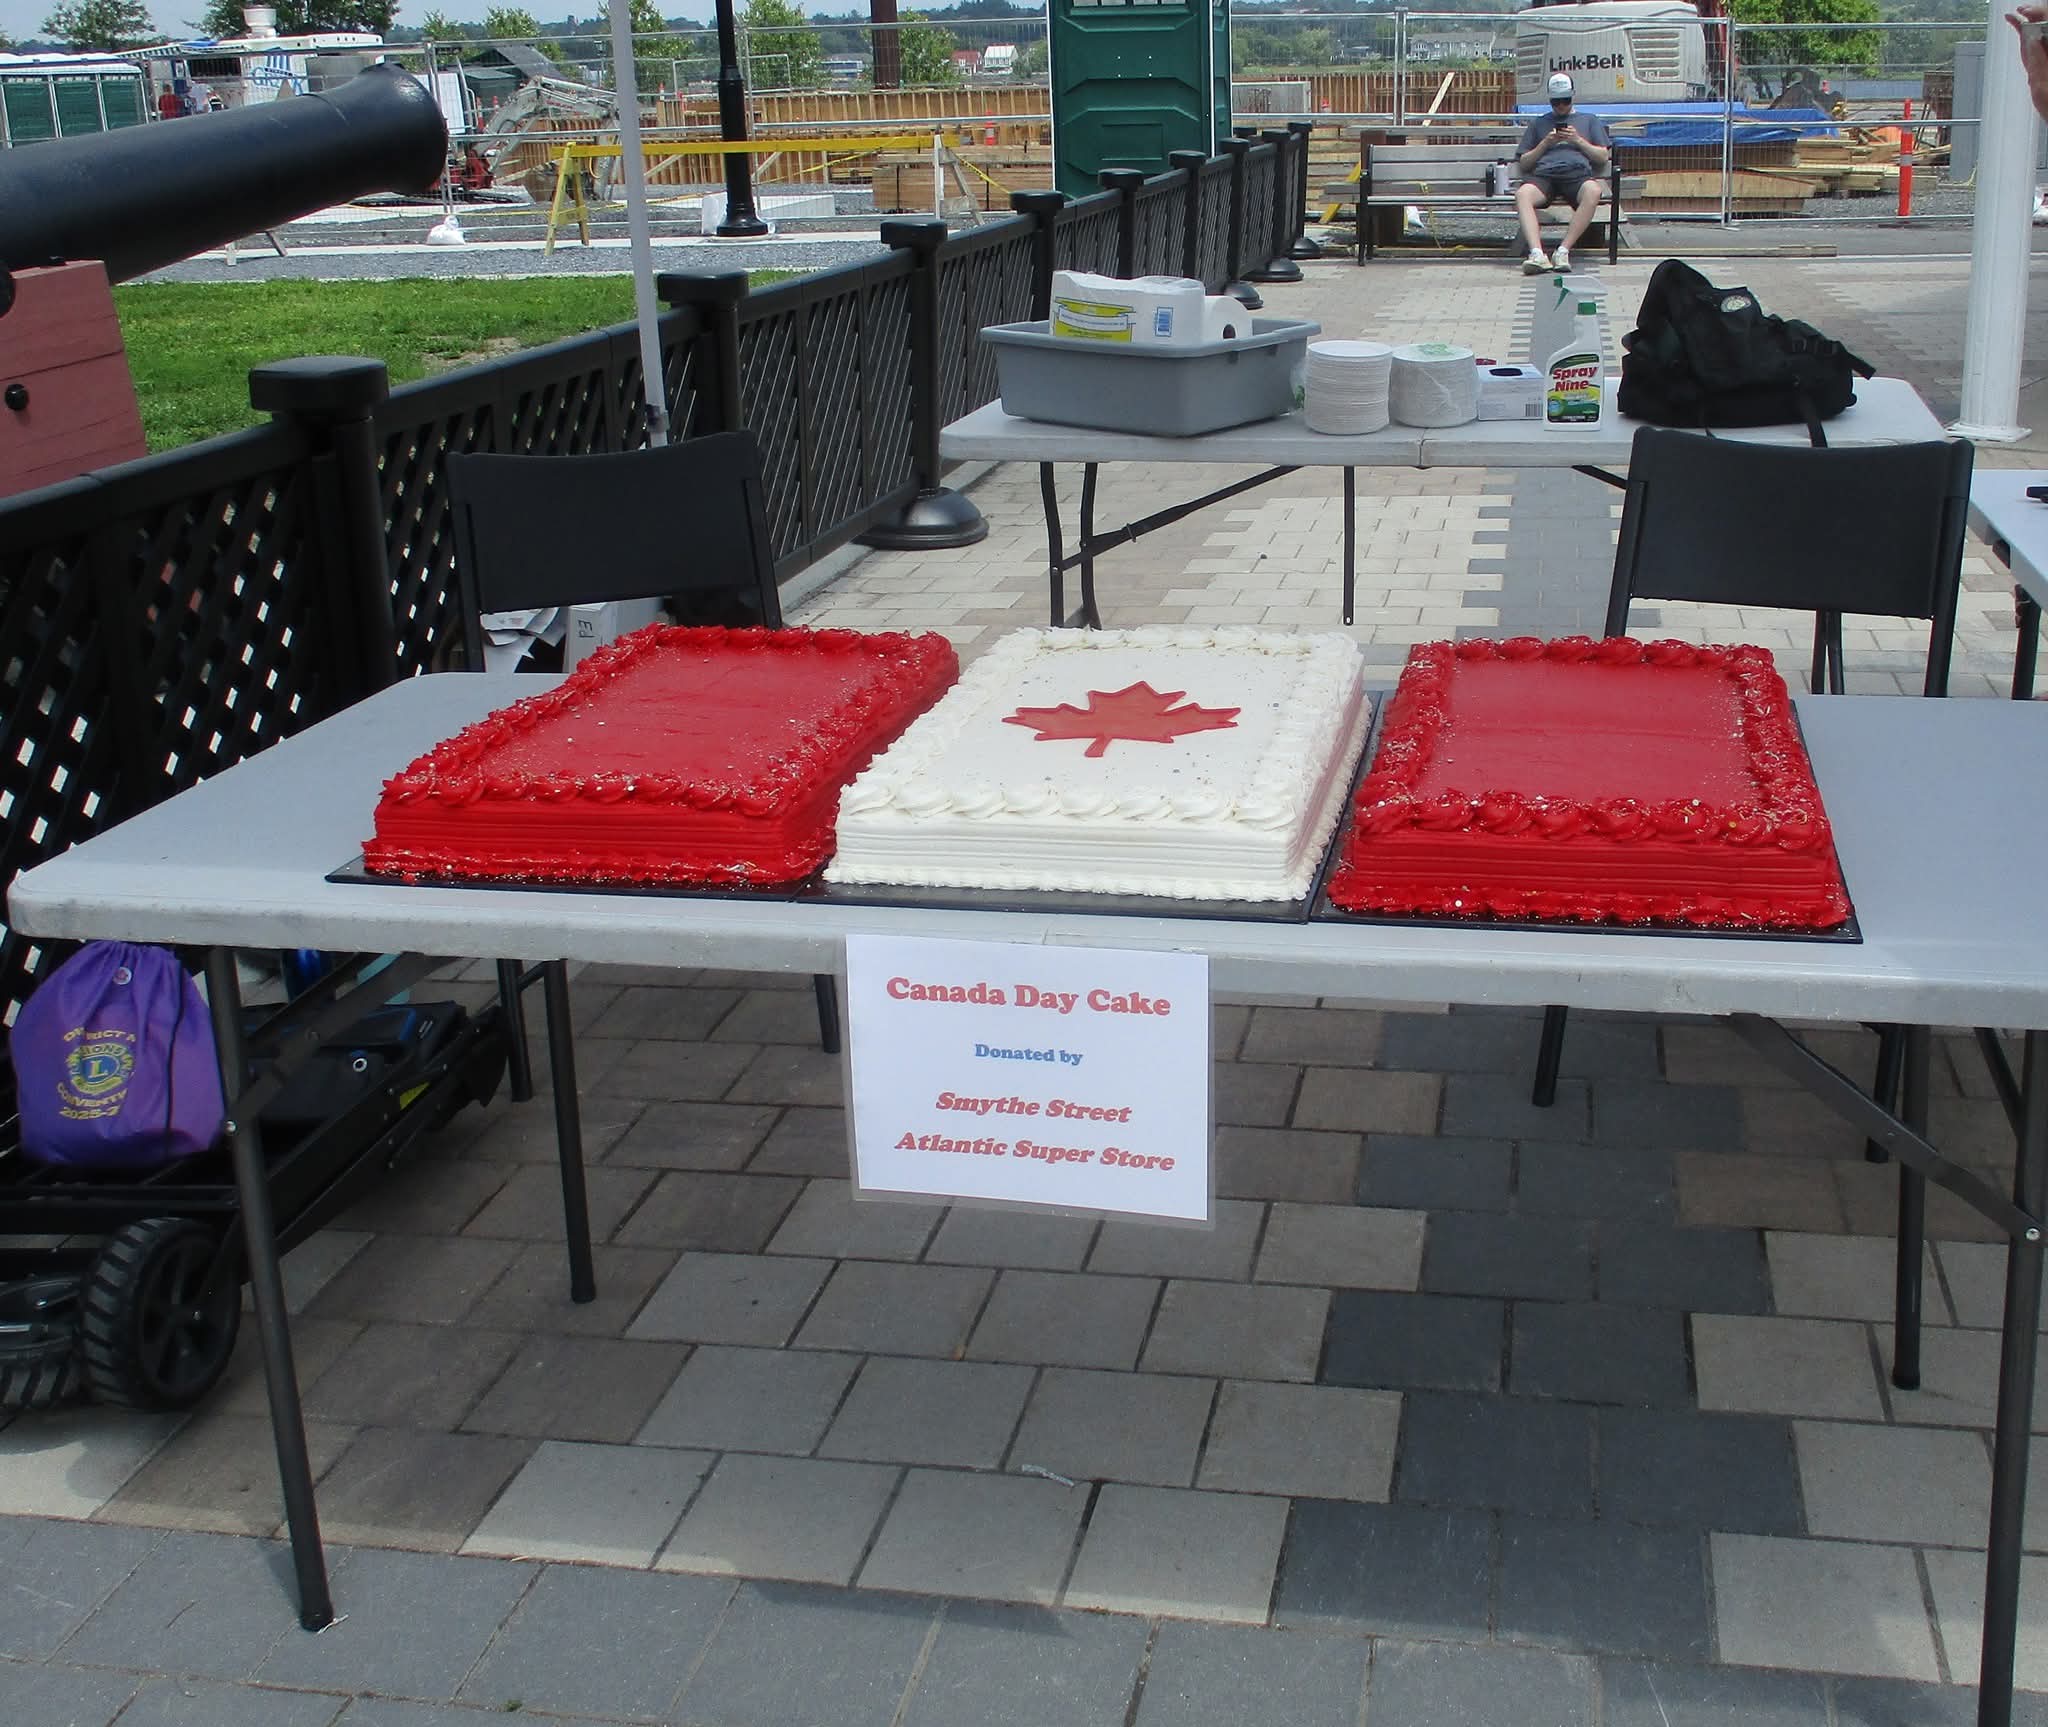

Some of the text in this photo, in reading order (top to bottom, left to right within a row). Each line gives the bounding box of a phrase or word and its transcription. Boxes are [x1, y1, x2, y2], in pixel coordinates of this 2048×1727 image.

[1550, 53, 1625, 72] Link-Belt
[251, 66, 304, 97] GREK
[1552, 366, 1599, 380] Spray
[1555, 380, 1589, 392] Nine
[886, 976, 1171, 1016] Canada Day Cake
[974, 1043, 1083, 1066] Donated by
[88, 1059, 109, 1079] L
[935, 1091, 1132, 1123] Smythe Street
[894, 1132, 1175, 1171] Atlantic Super Store
